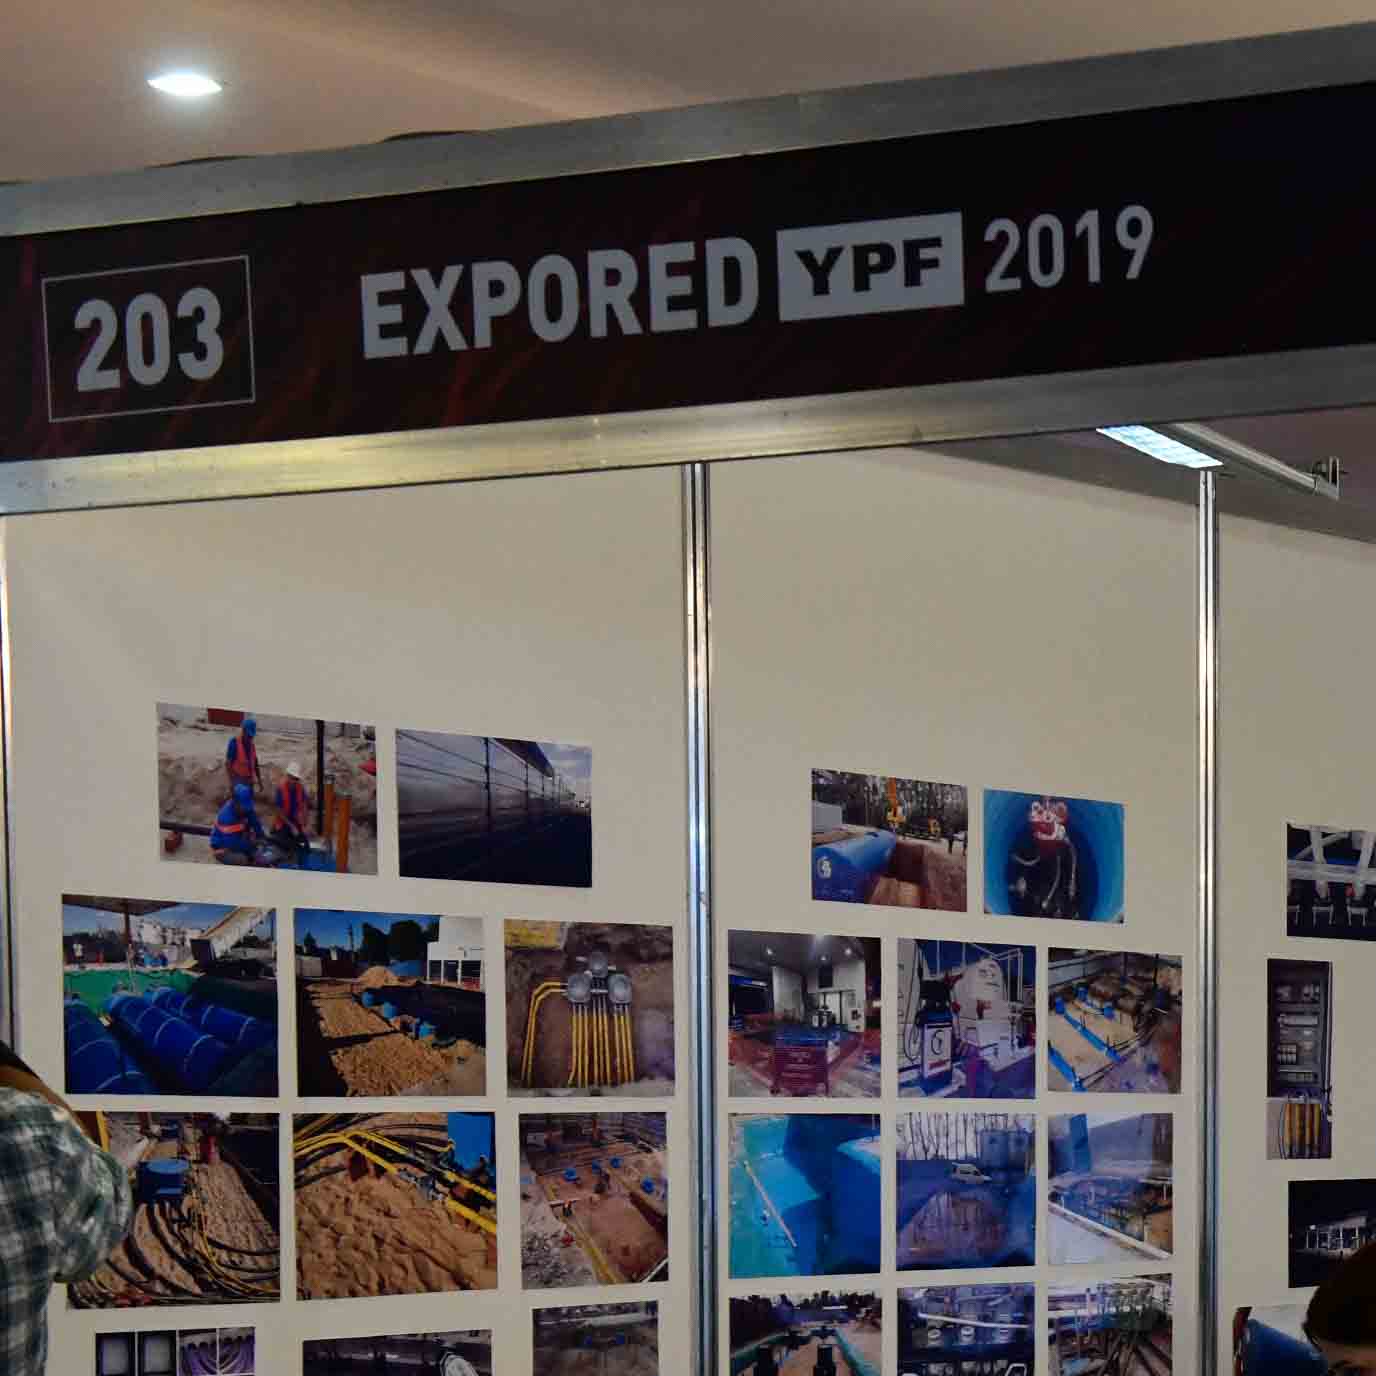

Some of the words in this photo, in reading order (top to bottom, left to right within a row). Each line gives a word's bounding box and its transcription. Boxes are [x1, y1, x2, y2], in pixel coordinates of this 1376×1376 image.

[74, 287, 224, 391] 203
[360, 236, 759, 360] EXPORED
[795, 236, 943, 296] YPF
[984, 205, 1154, 293] 2019
